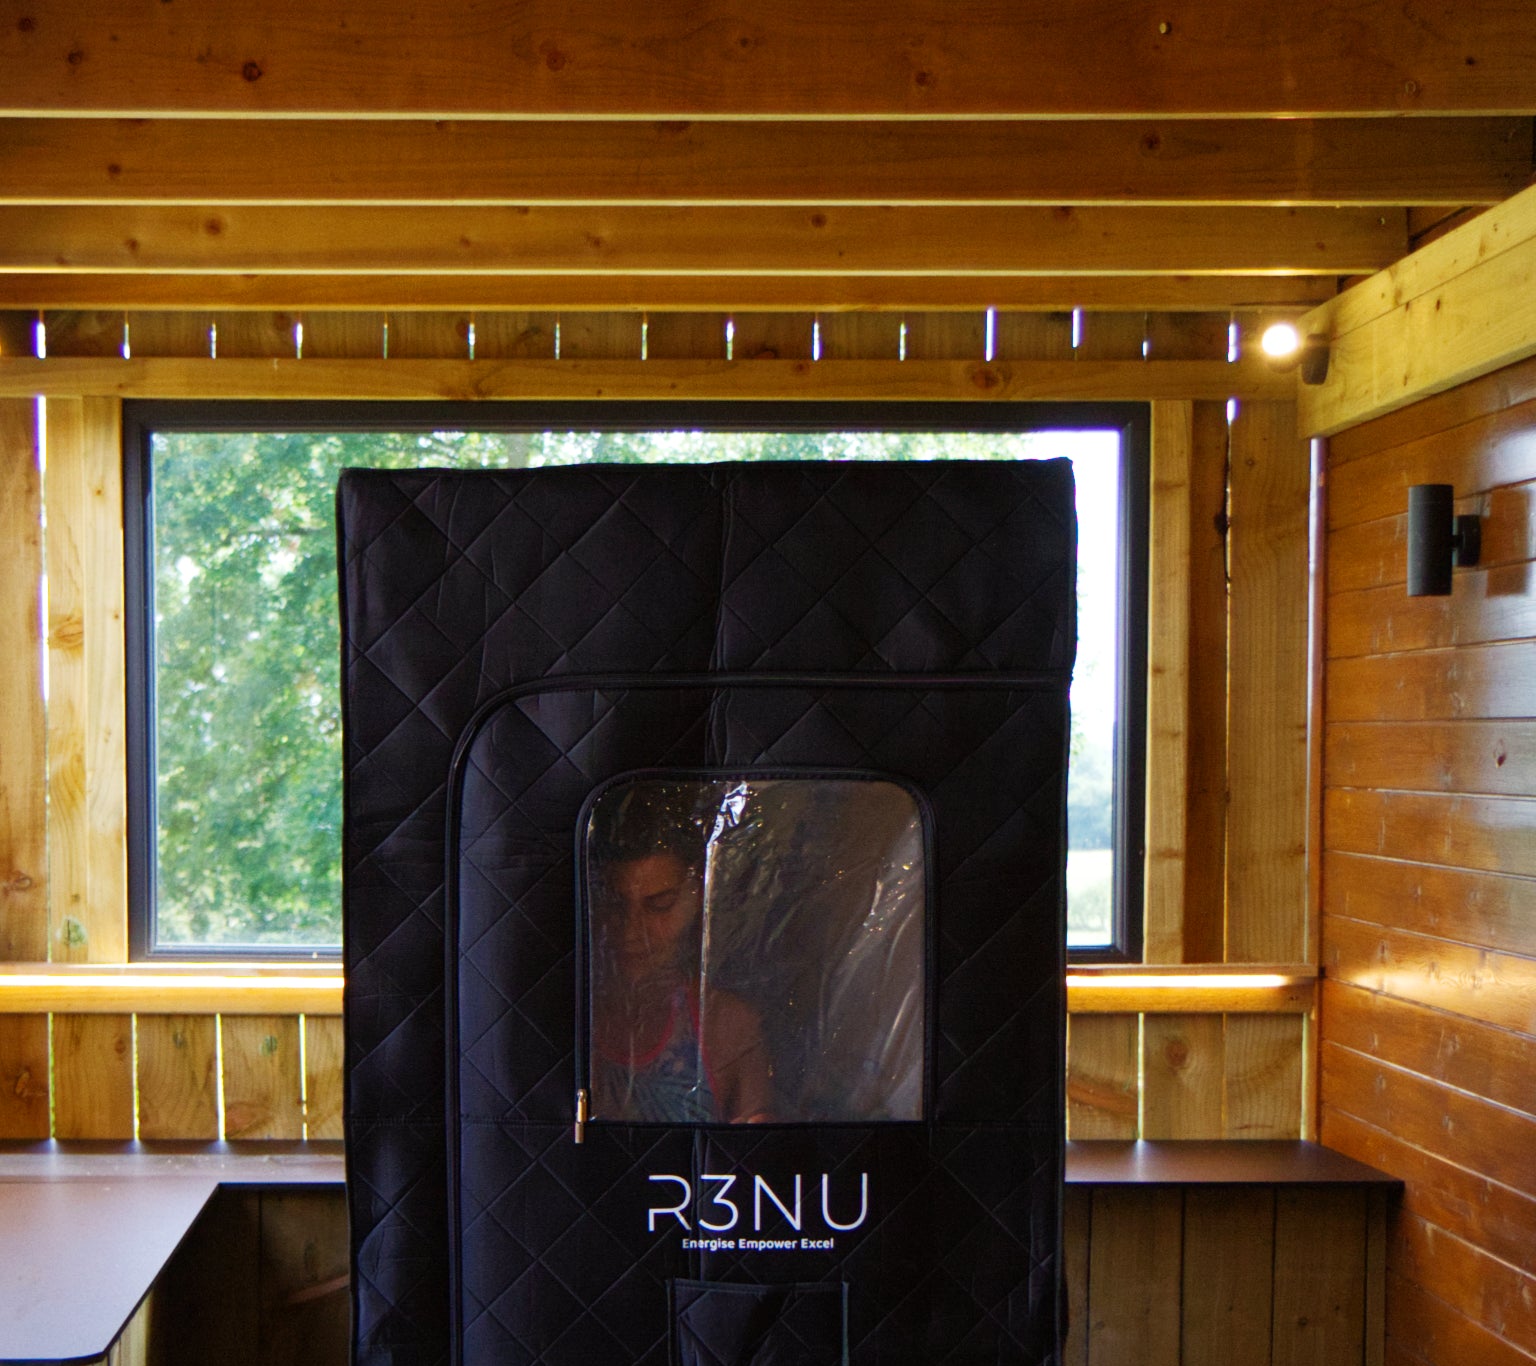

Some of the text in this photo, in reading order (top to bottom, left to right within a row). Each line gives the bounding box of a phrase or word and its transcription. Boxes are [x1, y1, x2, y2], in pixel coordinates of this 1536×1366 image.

[648, 1172, 869, 1232] R3NU
[682, 1237, 835, 1252] Energise Empower Excel
